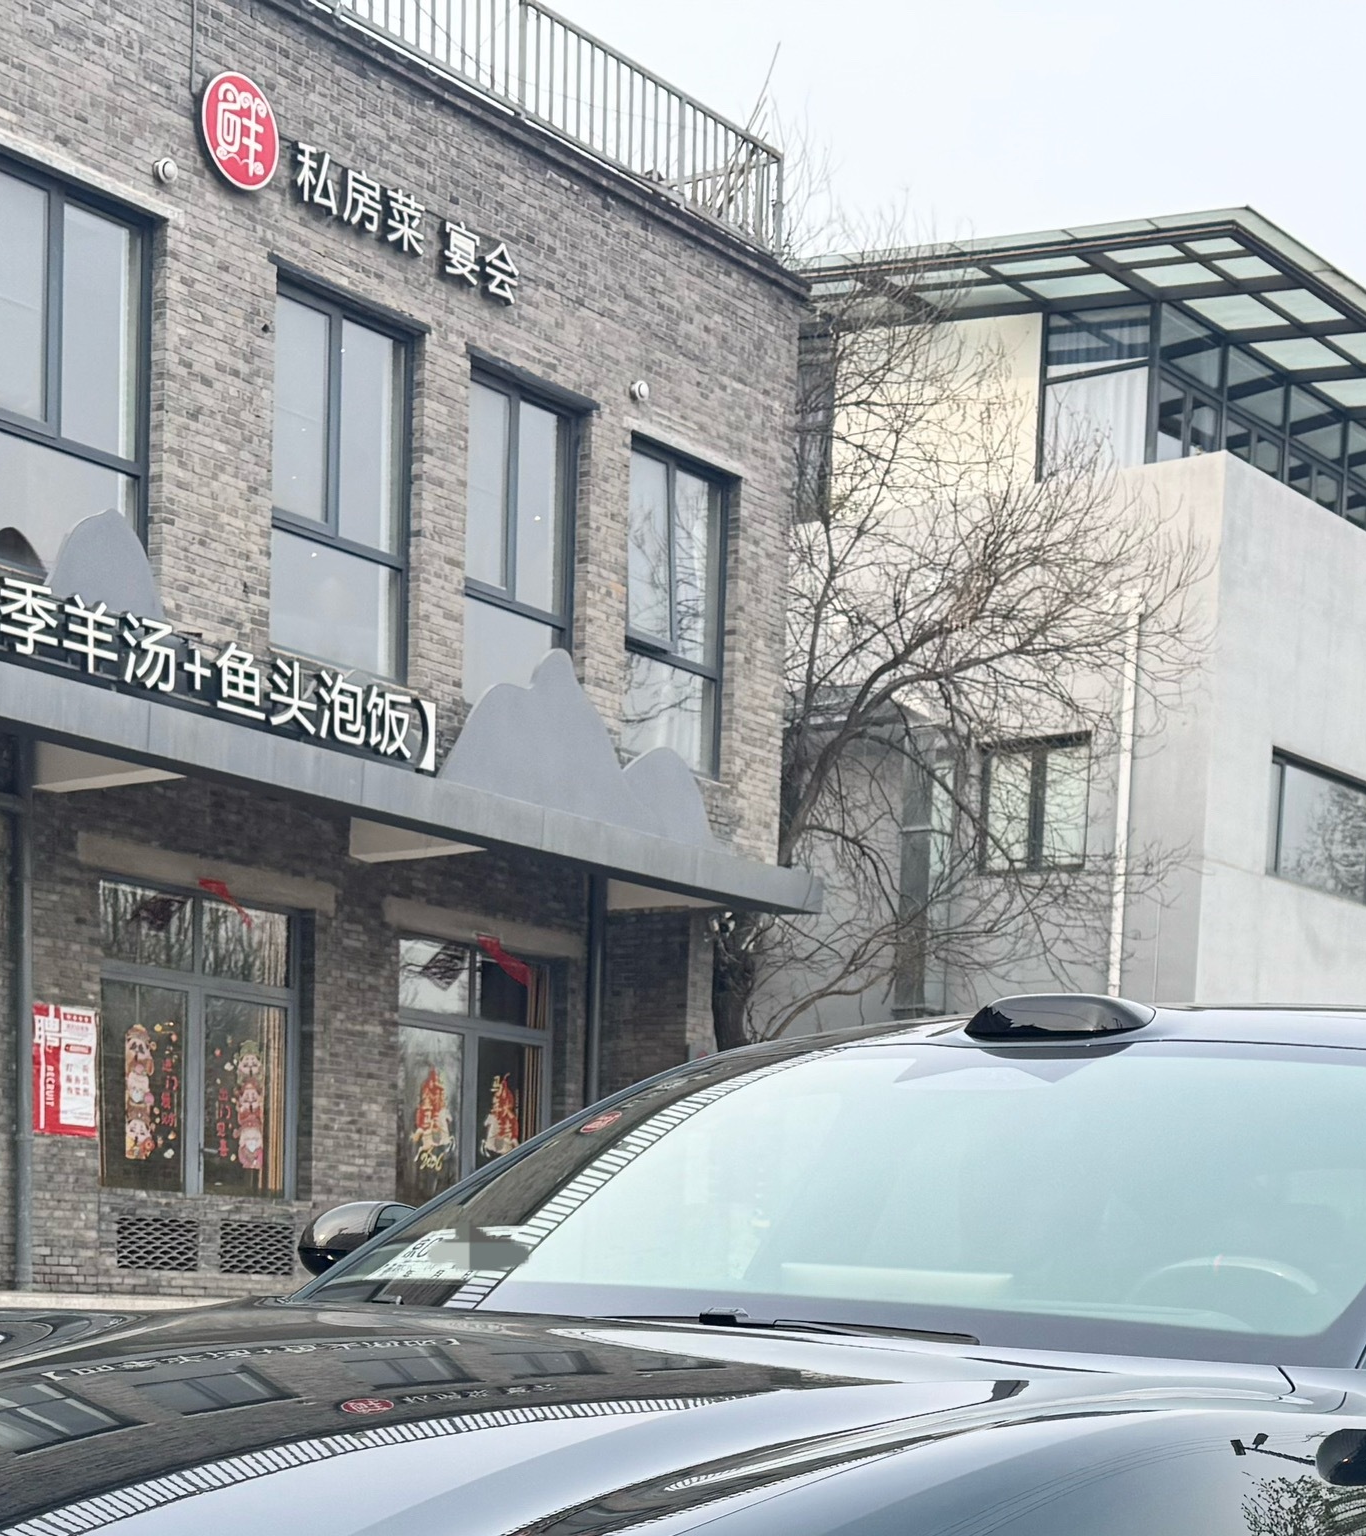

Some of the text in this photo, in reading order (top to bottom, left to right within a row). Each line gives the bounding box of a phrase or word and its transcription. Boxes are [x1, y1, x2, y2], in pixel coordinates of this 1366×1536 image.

[296, 141, 521, 305] 私房菜 宴会
[45, 1064, 55, 1107] RECRUIT
